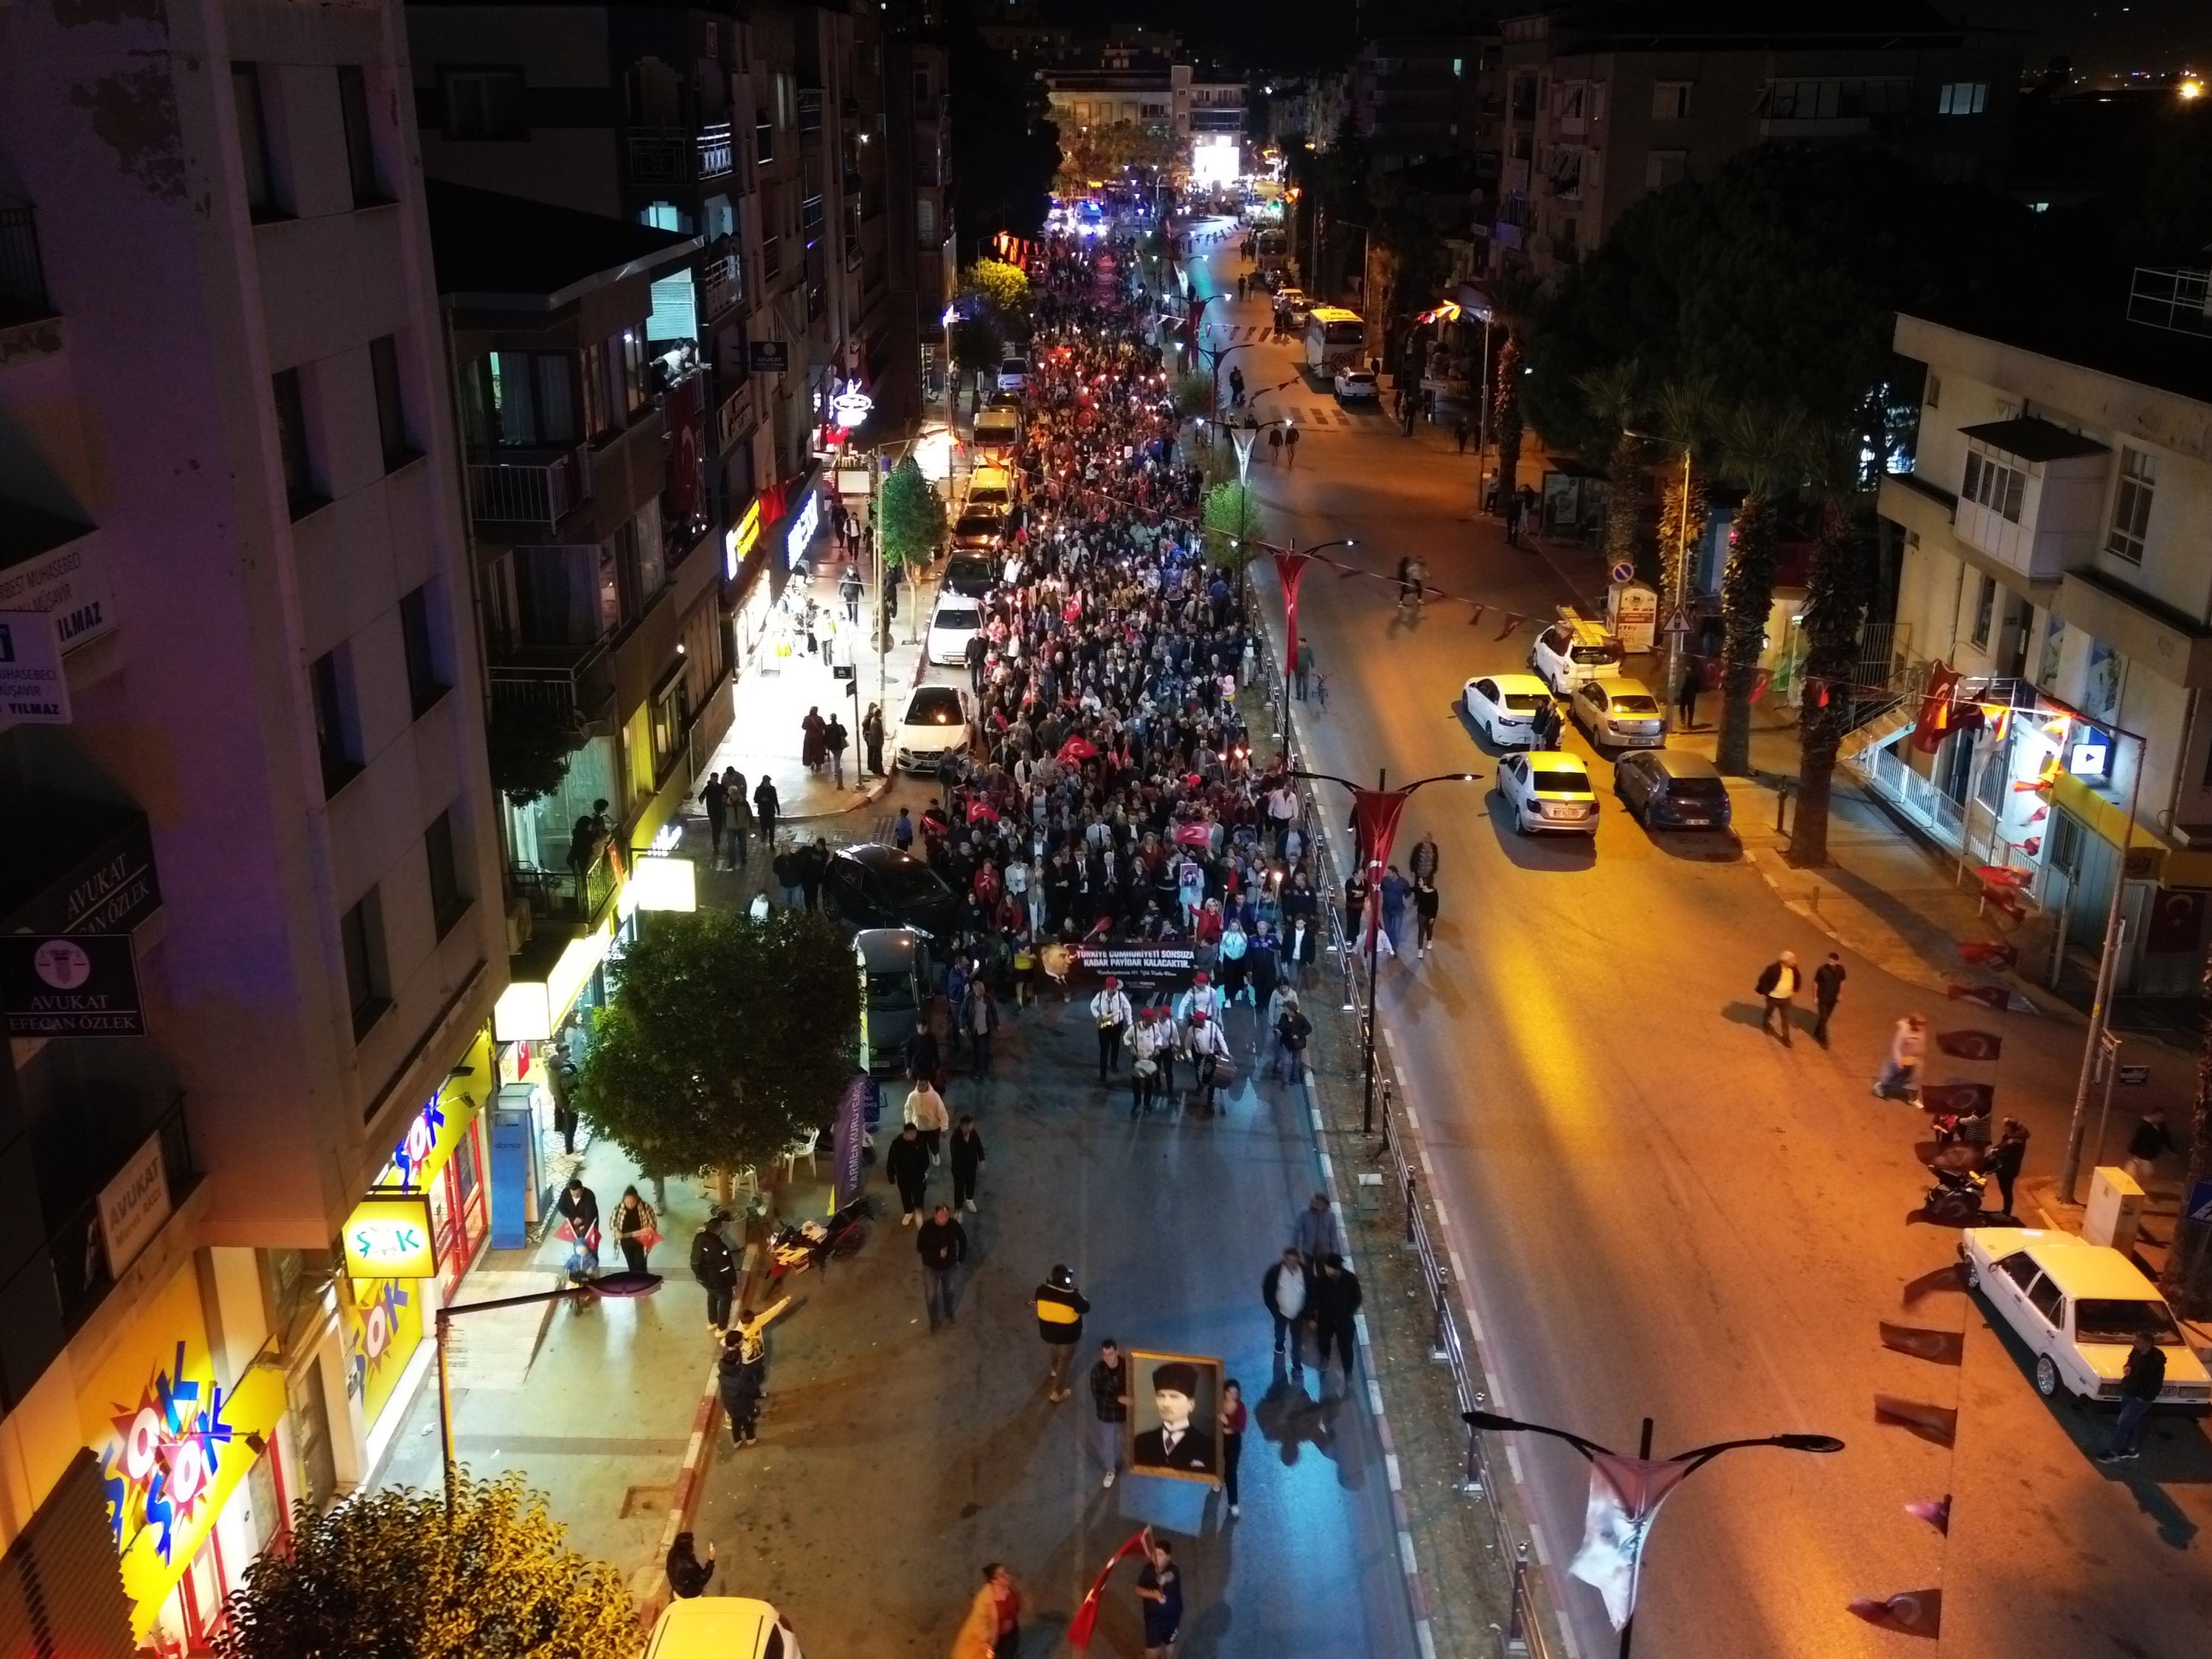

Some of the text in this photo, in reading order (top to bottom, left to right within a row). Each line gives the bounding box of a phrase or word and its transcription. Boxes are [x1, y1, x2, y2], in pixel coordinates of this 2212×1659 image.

[58, 602, 102, 642] ILMAZ
[0, 667, 57, 681] UHASEBECİ
[8, 703, 60, 715] YILMAZ
[67, 852, 126, 921] AVUKAT
[107, 877, 150, 924] ÖZLEK
[1077, 948, 1194, 959] TÜRKİYE CUMHURİYETİ SONSUZA
[1083, 957, 1191, 969] KADAR PAYİDAR KALACAKTIR.
[30, 995, 110, 1010] AVUKAT
[9, 1015, 137, 1031] EFECAN ÖZLEK
[849, 1144, 860, 1191] KARMEN
[110, 1155, 159, 1232] AVUKAT
[357, 1228, 420, 1258] ŞK
